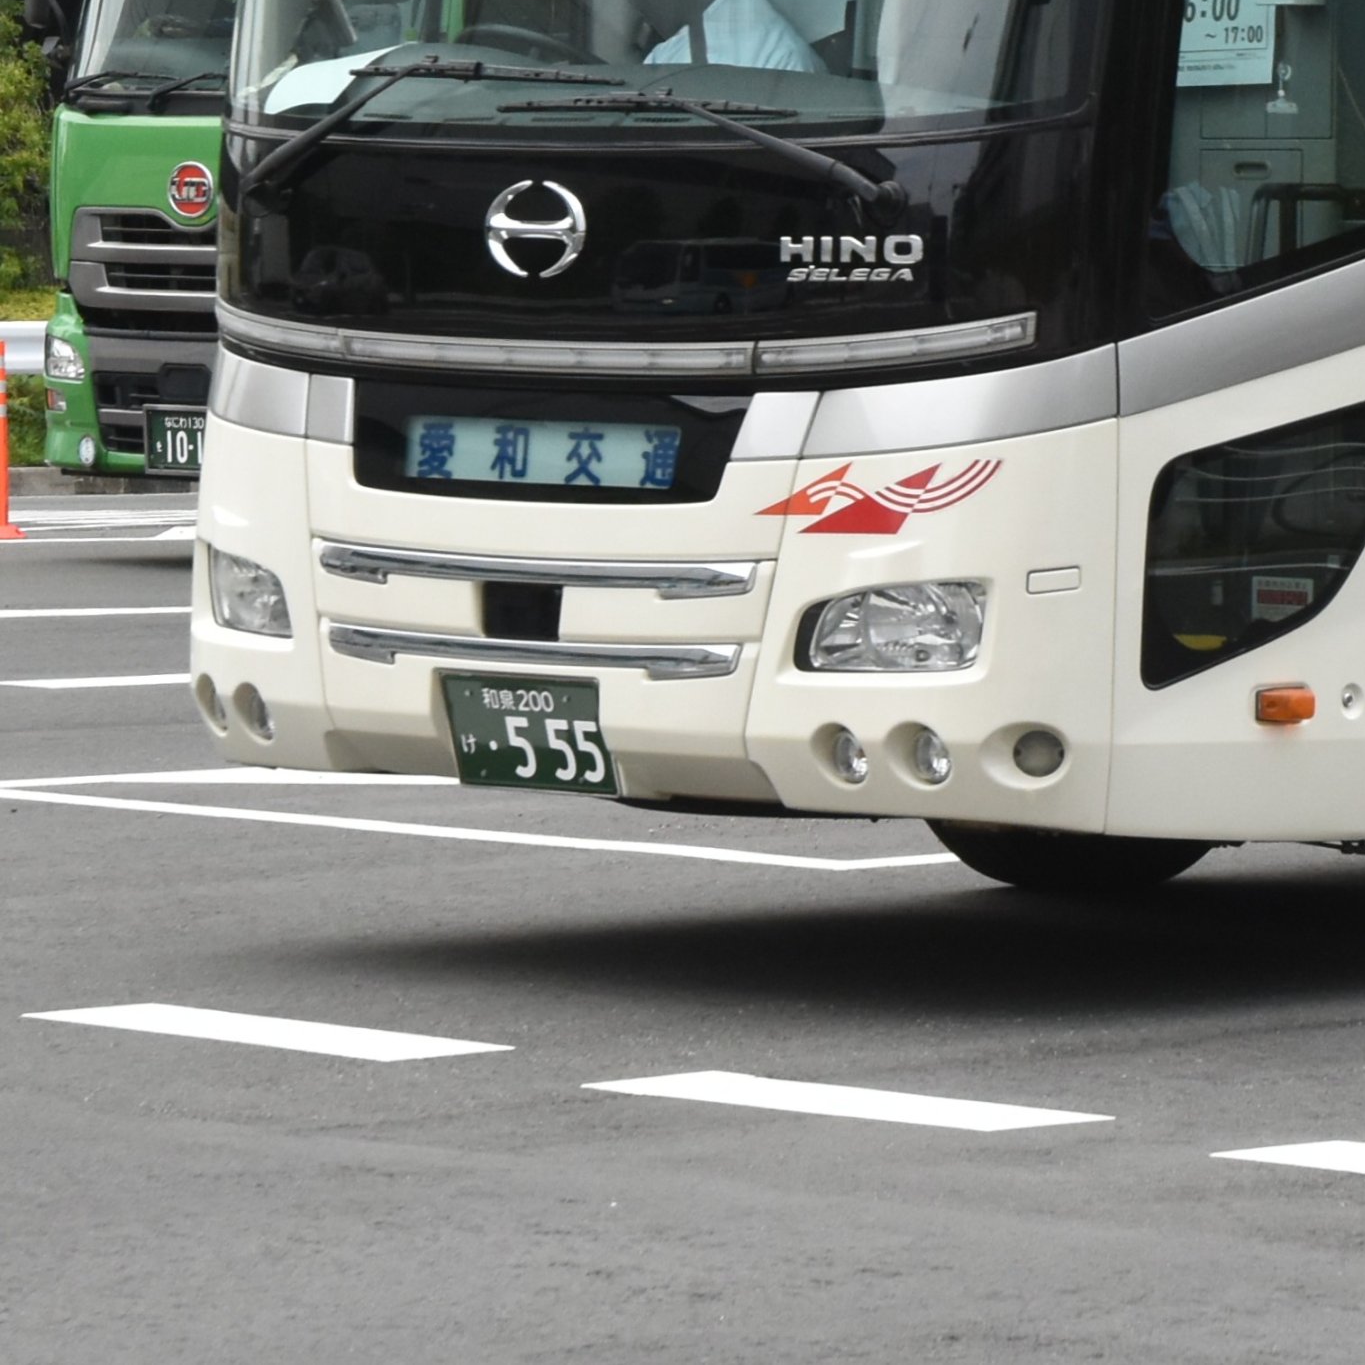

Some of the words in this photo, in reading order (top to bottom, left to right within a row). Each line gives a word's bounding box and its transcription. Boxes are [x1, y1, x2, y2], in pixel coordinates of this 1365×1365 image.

[1224, 25, 1264, 44] 17:00
[779, 234, 924, 264] HINO
[417, 422, 682, 488] 愛和交通
